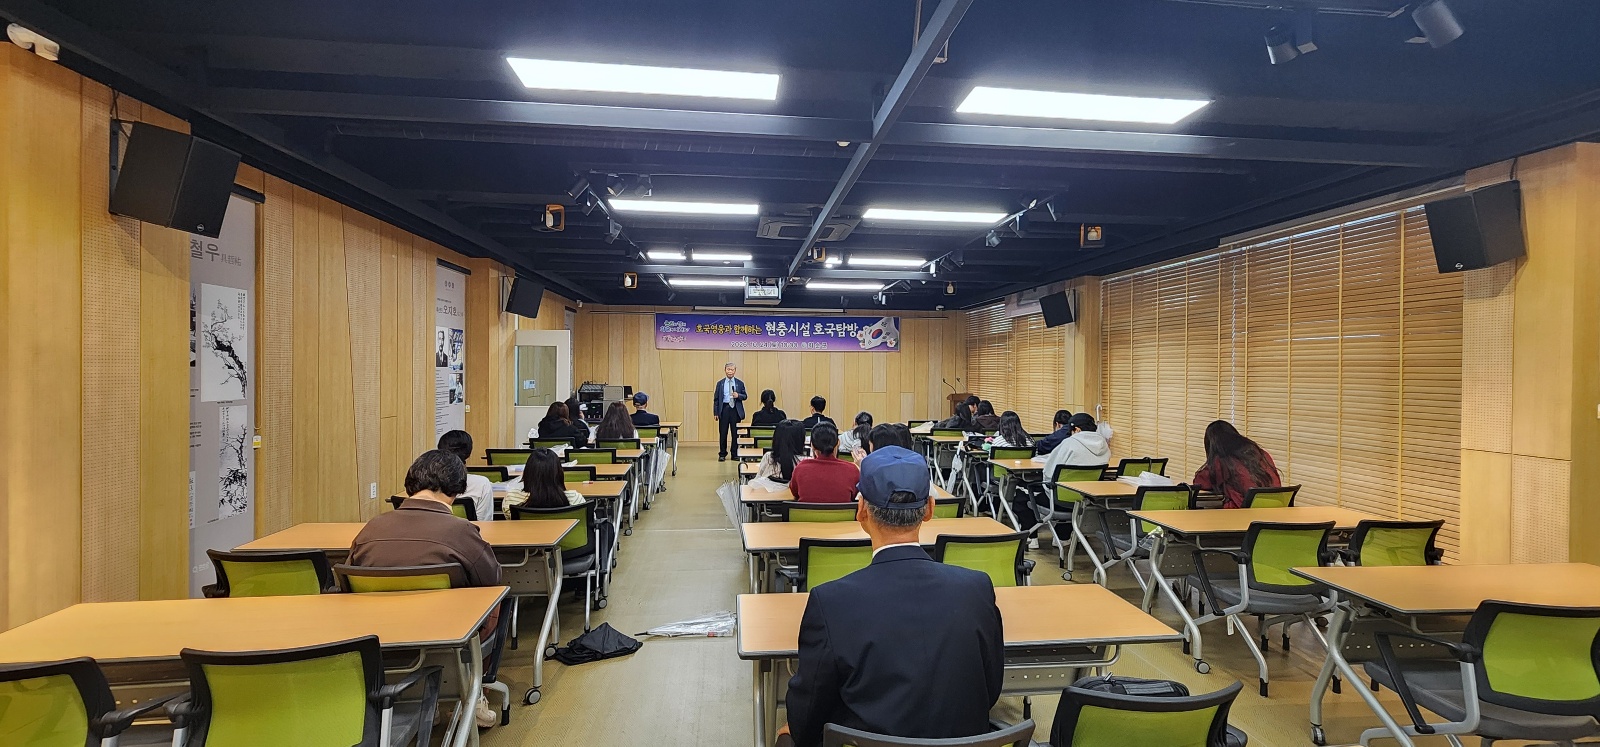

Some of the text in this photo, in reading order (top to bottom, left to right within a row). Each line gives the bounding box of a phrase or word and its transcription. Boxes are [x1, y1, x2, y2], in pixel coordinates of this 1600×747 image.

[695, 324, 732, 335] 호국영웅과
[733, 324, 762, 335] 함께하는
[765, 321, 811, 337] 현충시설
[813, 322, 858, 338] 호국탐방
